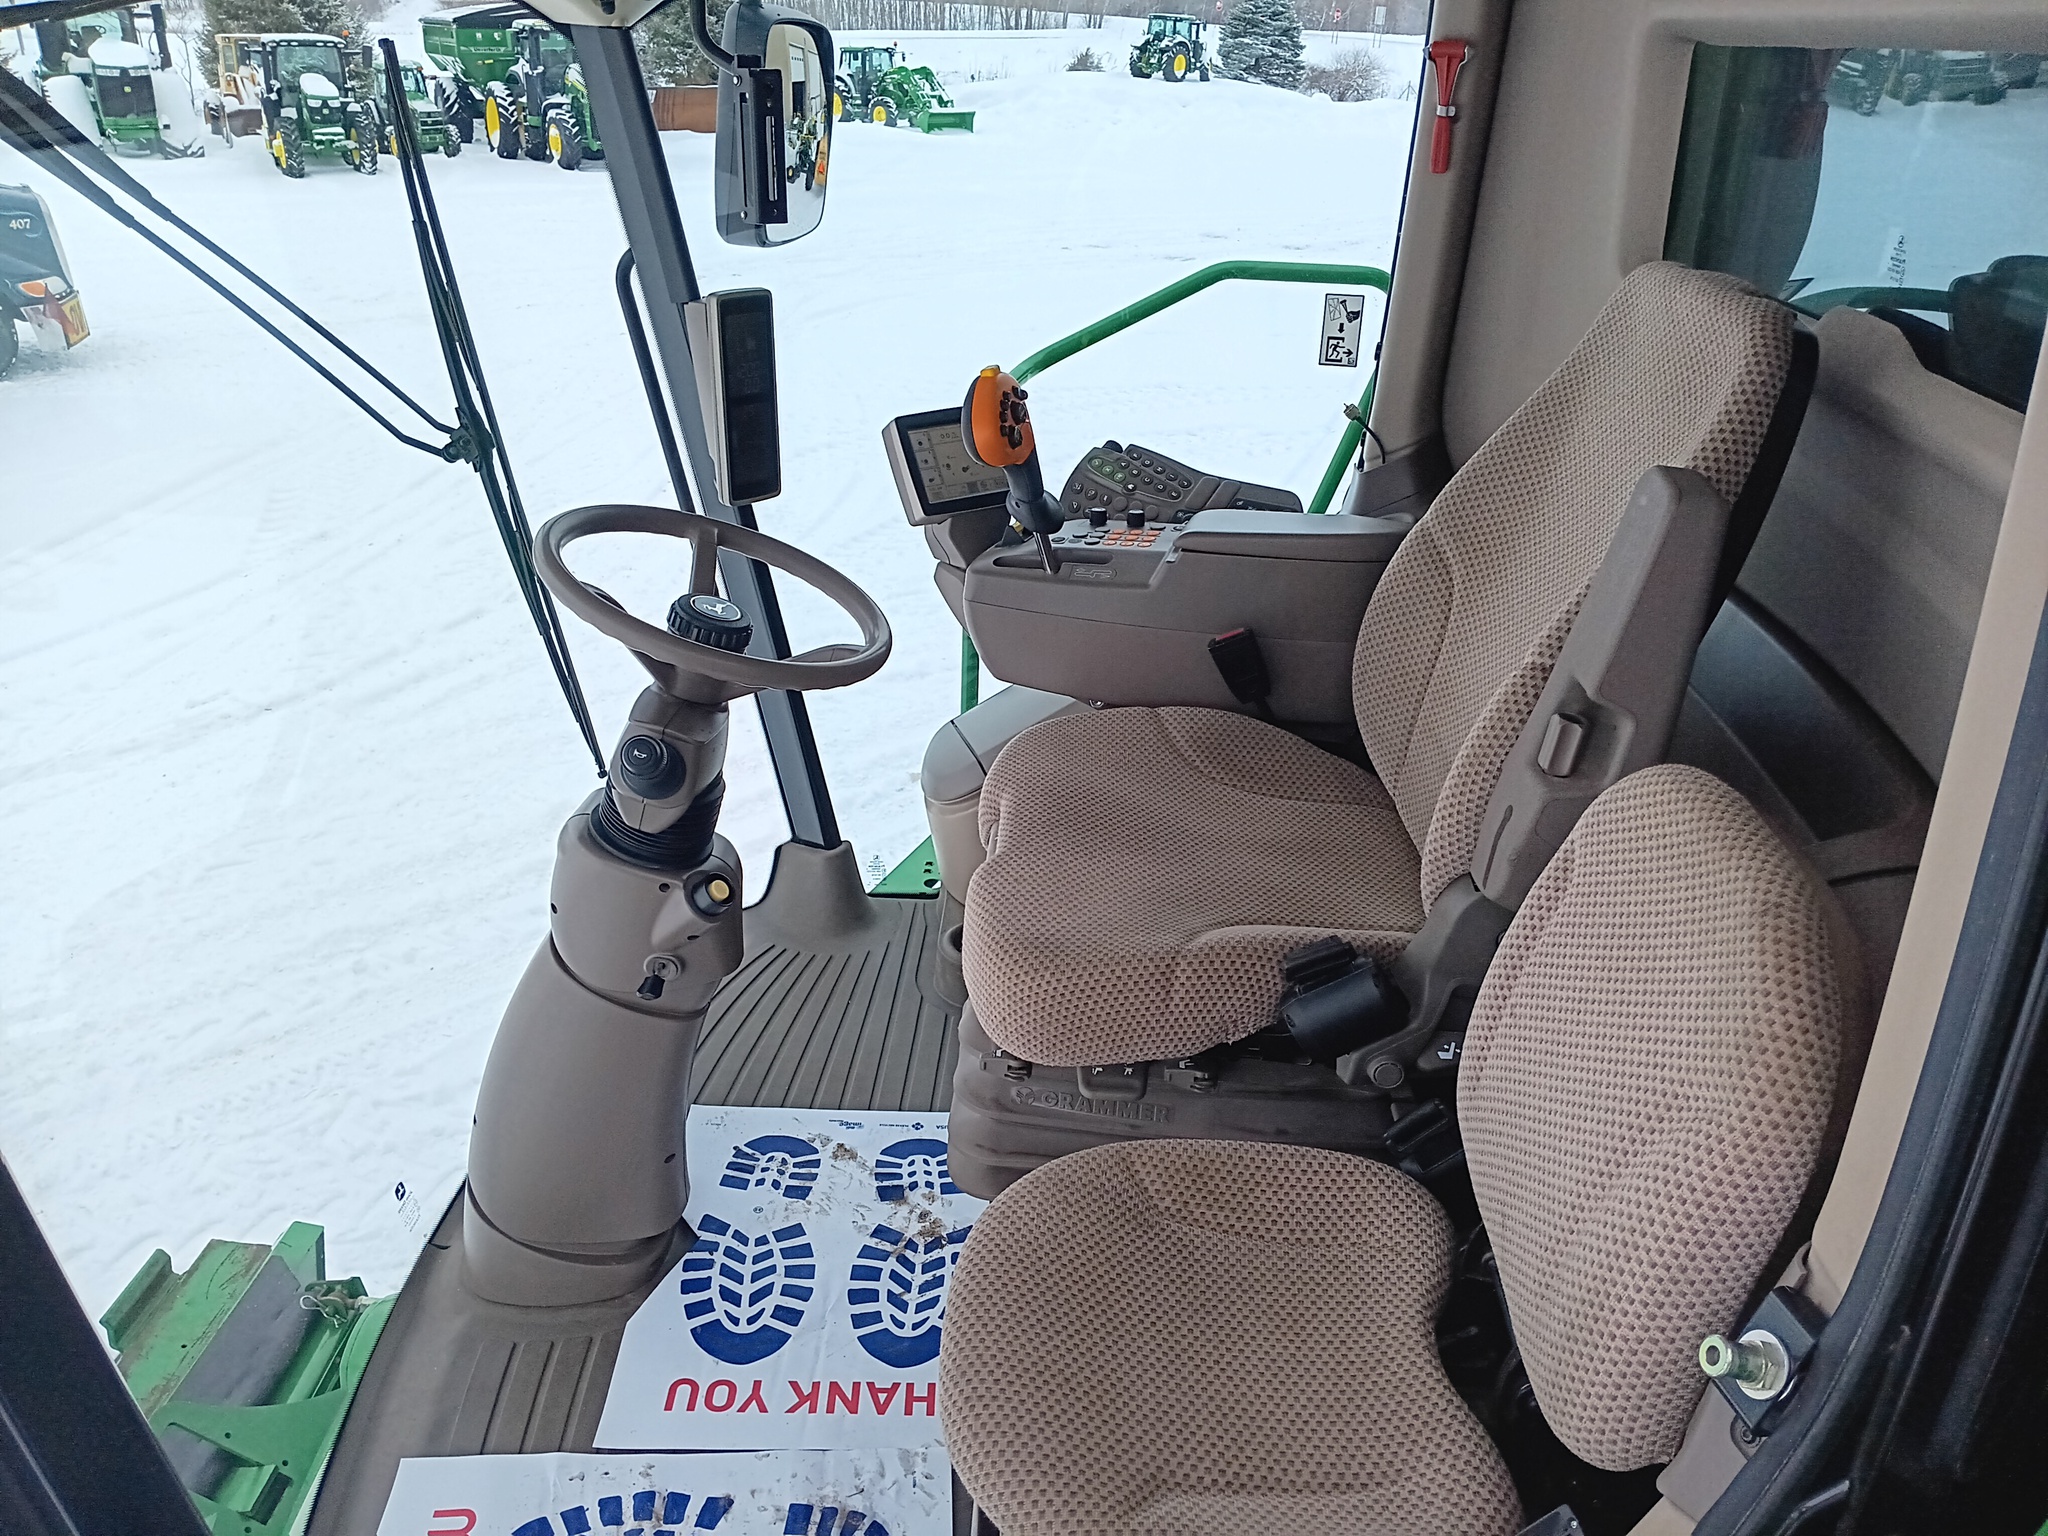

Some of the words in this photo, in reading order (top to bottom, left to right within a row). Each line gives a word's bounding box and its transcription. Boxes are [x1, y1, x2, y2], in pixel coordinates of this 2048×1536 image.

[9, 218, 31, 230] 407
[1041, 1090, 1169, 1122] GRAMMER
[663, 1377, 769, 1414] YOU
[784, 1380, 937, 1417] HANK
